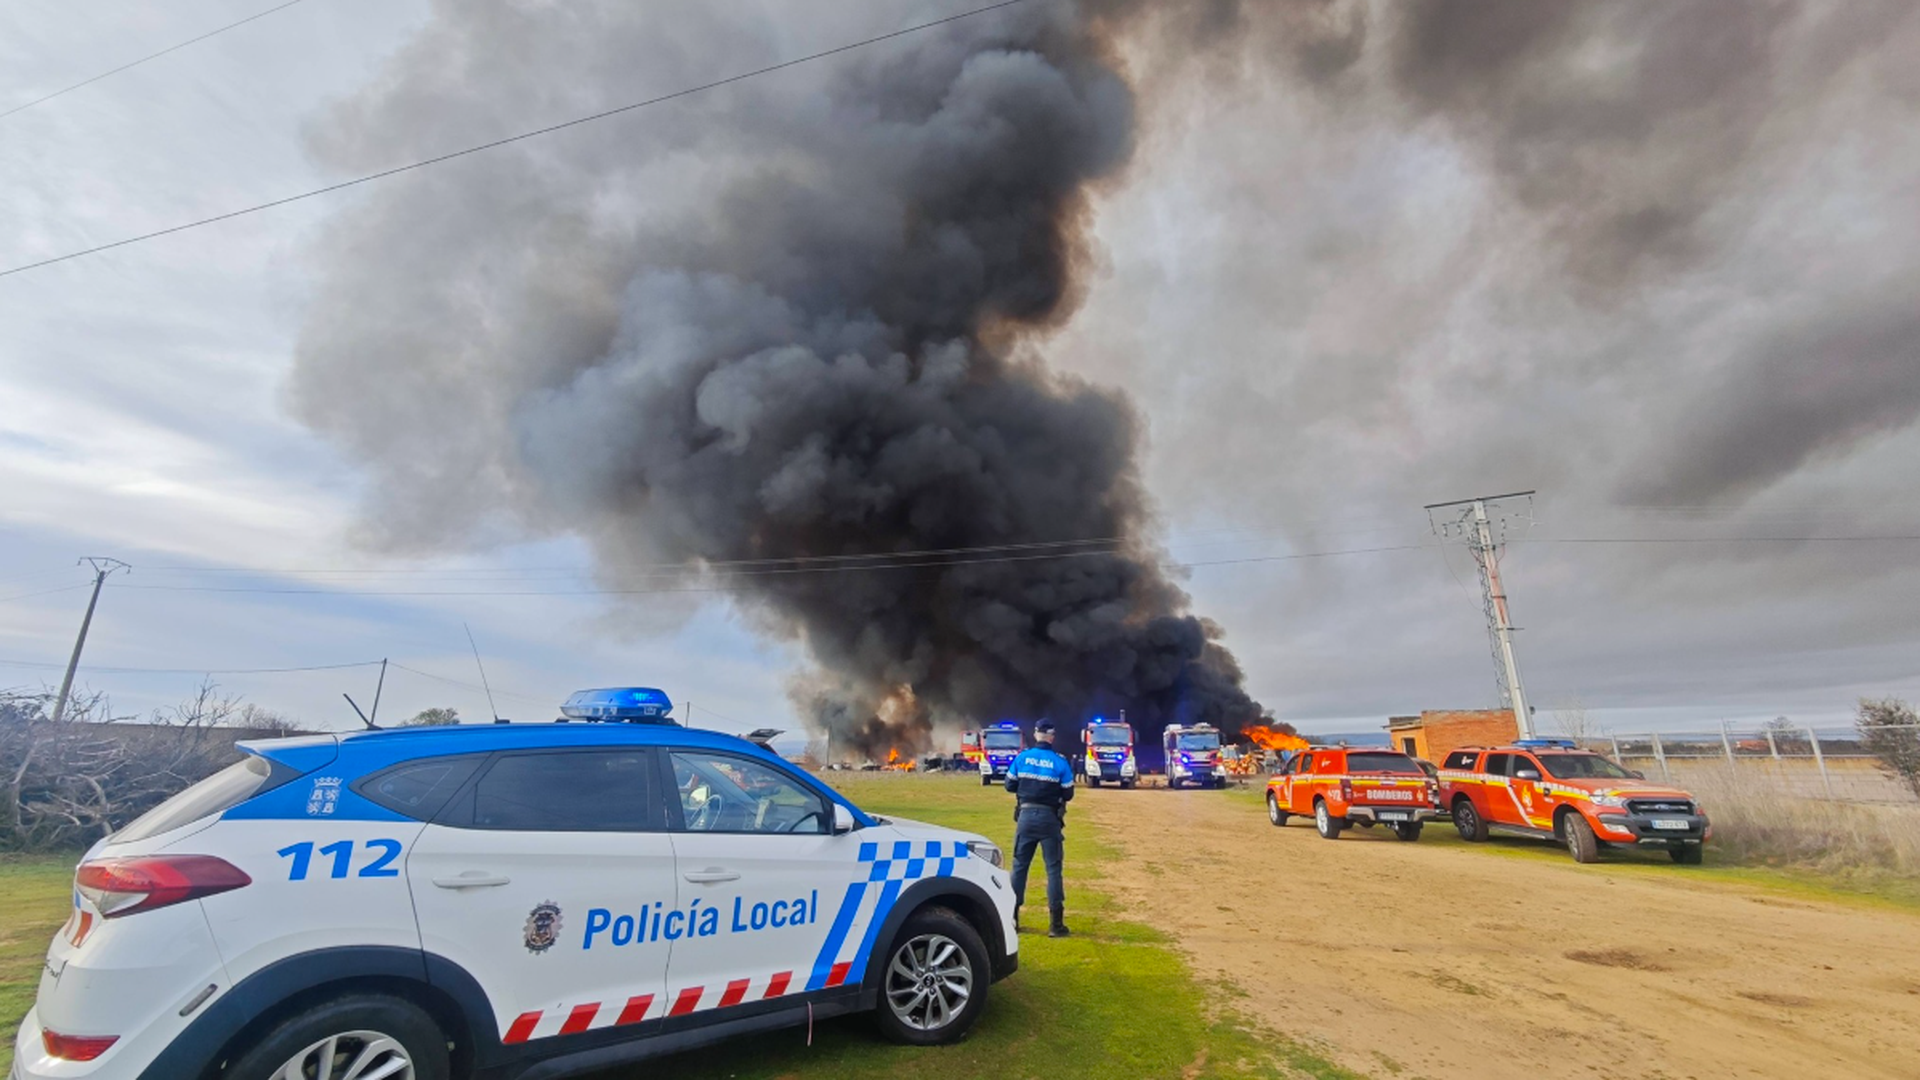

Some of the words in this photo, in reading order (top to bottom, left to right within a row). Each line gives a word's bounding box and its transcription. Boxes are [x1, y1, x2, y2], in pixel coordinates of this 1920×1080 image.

[1366, 789, 1413, 801] BOMBEROS
[277, 838, 403, 881] 112
[583, 898, 719, 950] Policía
[731, 889, 818, 933] Local
